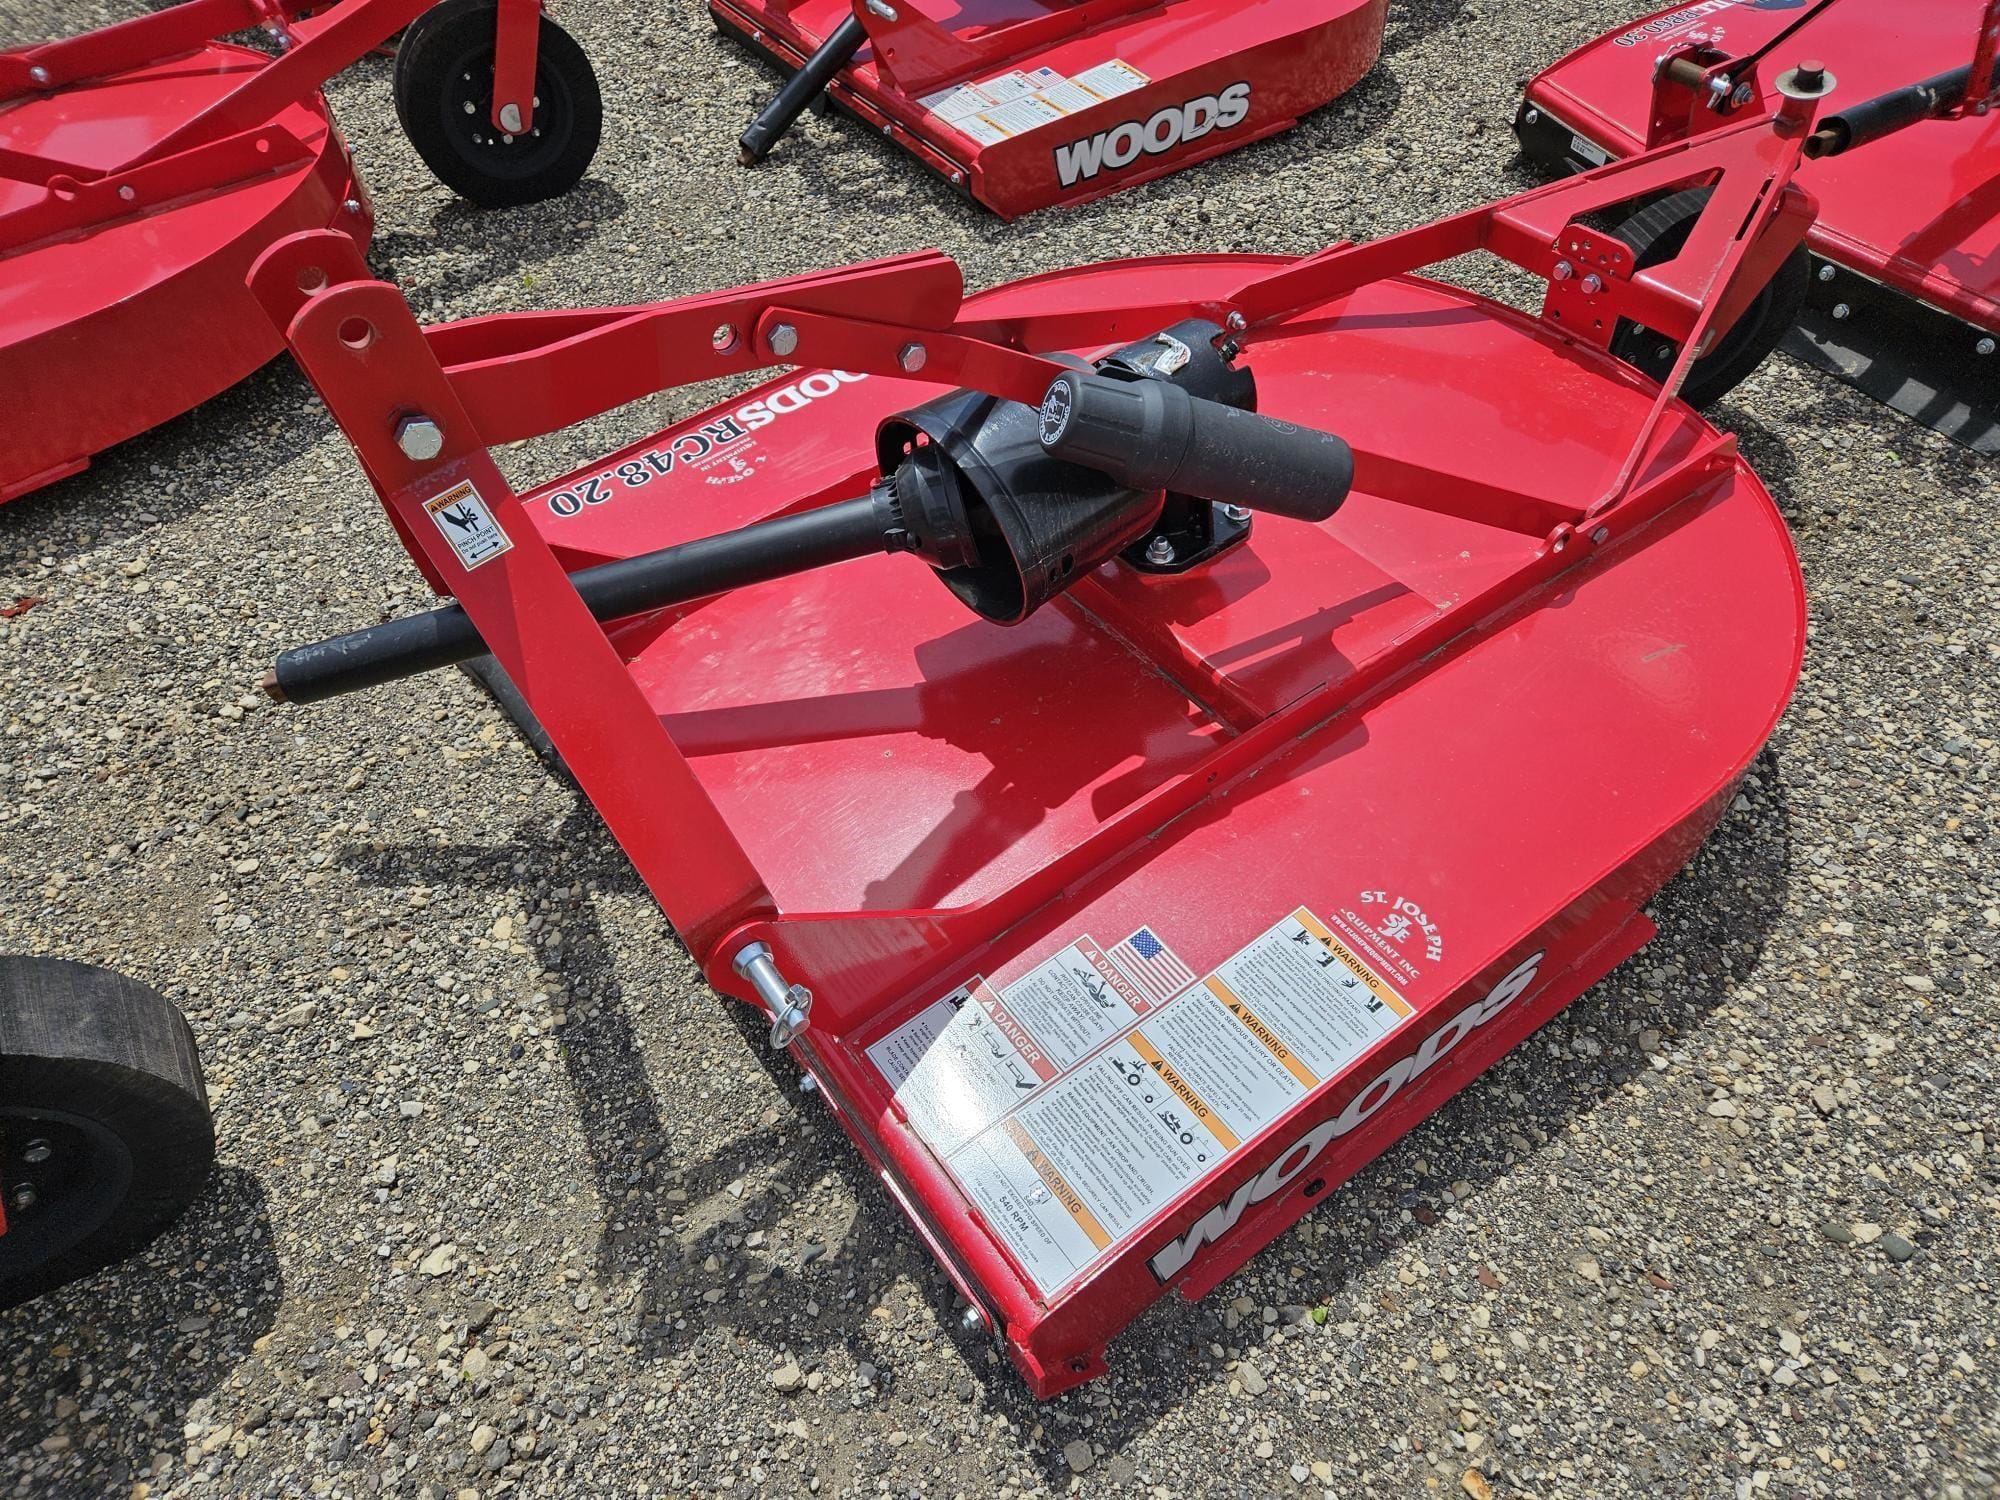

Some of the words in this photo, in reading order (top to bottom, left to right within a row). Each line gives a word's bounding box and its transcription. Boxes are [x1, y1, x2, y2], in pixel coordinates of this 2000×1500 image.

[1053, 80, 1252, 189] WOODS
[549, 417, 748, 517] RC48.20
[435, 486, 471, 508] WARNING
[457, 535, 477, 549] PINCH
[475, 525, 494, 539] POINT
[1340, 908, 1400, 958] QUIPMENT
[1399, 960, 1420, 979] INC
[1360, 891, 1387, 903] ST.
[1392, 896, 1442, 961] JOSEPH
[1042, 983, 1054, 995] NOT
[1095, 959, 1142, 1007] DANGER
[1311, 967, 1323, 978] AND
[1331, 944, 1380, 989] WARNING
[994, 1010, 1041, 1064] DANGER
[1200, 991, 1211, 1001] TO
[1207, 998, 1226, 1017] AVOID
[1223, 1014, 1249, 1040] SERIOUS
[1245, 1038, 1268, 1060] INJURY
[1264, 1057, 1277, 1069] OR
[1240, 1011, 1289, 1059] WARNING
[1095, 1063, 1116, 1085] FALLING
[1112, 1082, 1124, 1094] OFF
[1130, 1103, 1150, 1124] RESULT
[1145, 949, 1545, 1286] WOODS
[1161, 1068, 1209, 1118] WARNING
[1065, 1091, 1084, 1111] RAISED
[1104, 1136, 1117, 1150] CAN
[1022, 1194, 1034, 1206] 540
[1036, 1160, 1083, 1214] WARNING
[998, 1195, 1014, 1212] 540
[1009, 1209, 1029, 1232] RPM
